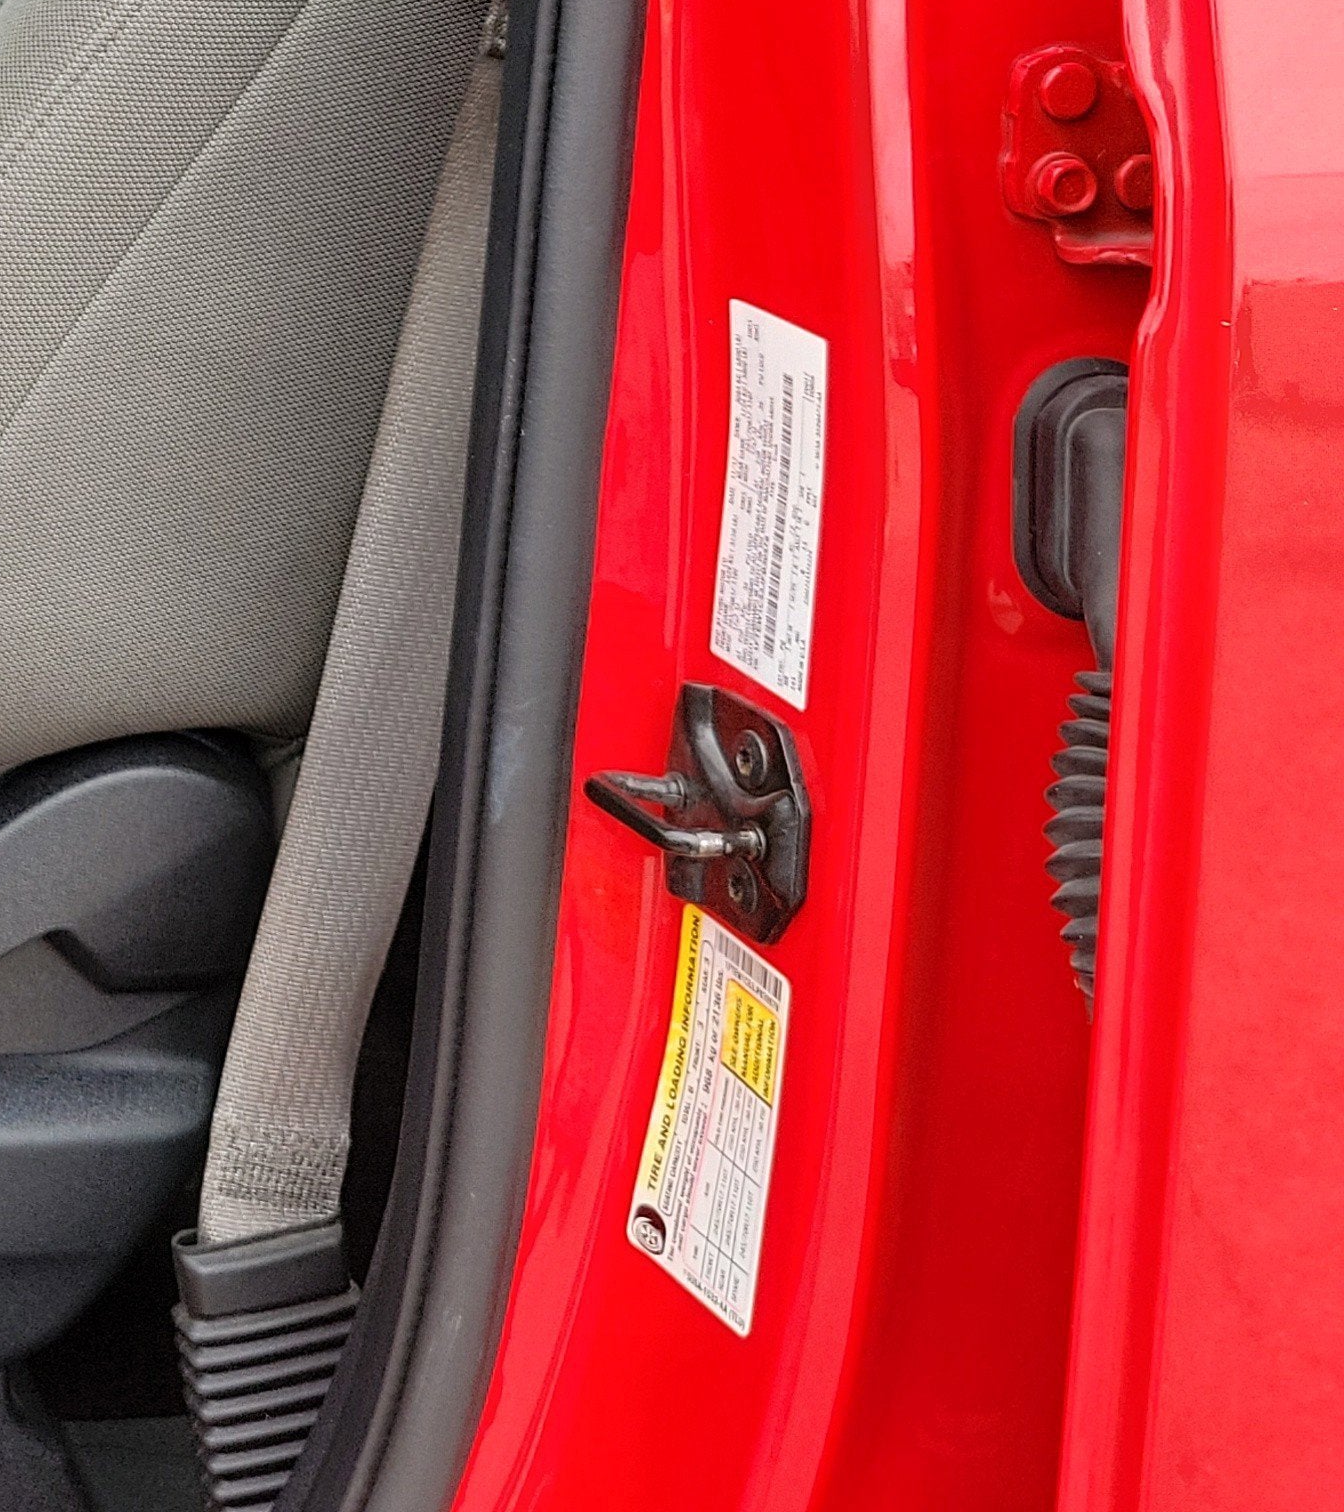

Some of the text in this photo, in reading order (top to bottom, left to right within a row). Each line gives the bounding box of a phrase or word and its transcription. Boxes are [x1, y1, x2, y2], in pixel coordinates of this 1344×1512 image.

[647, 914, 701, 1191] TIRE AND LOADING INFORMATION
